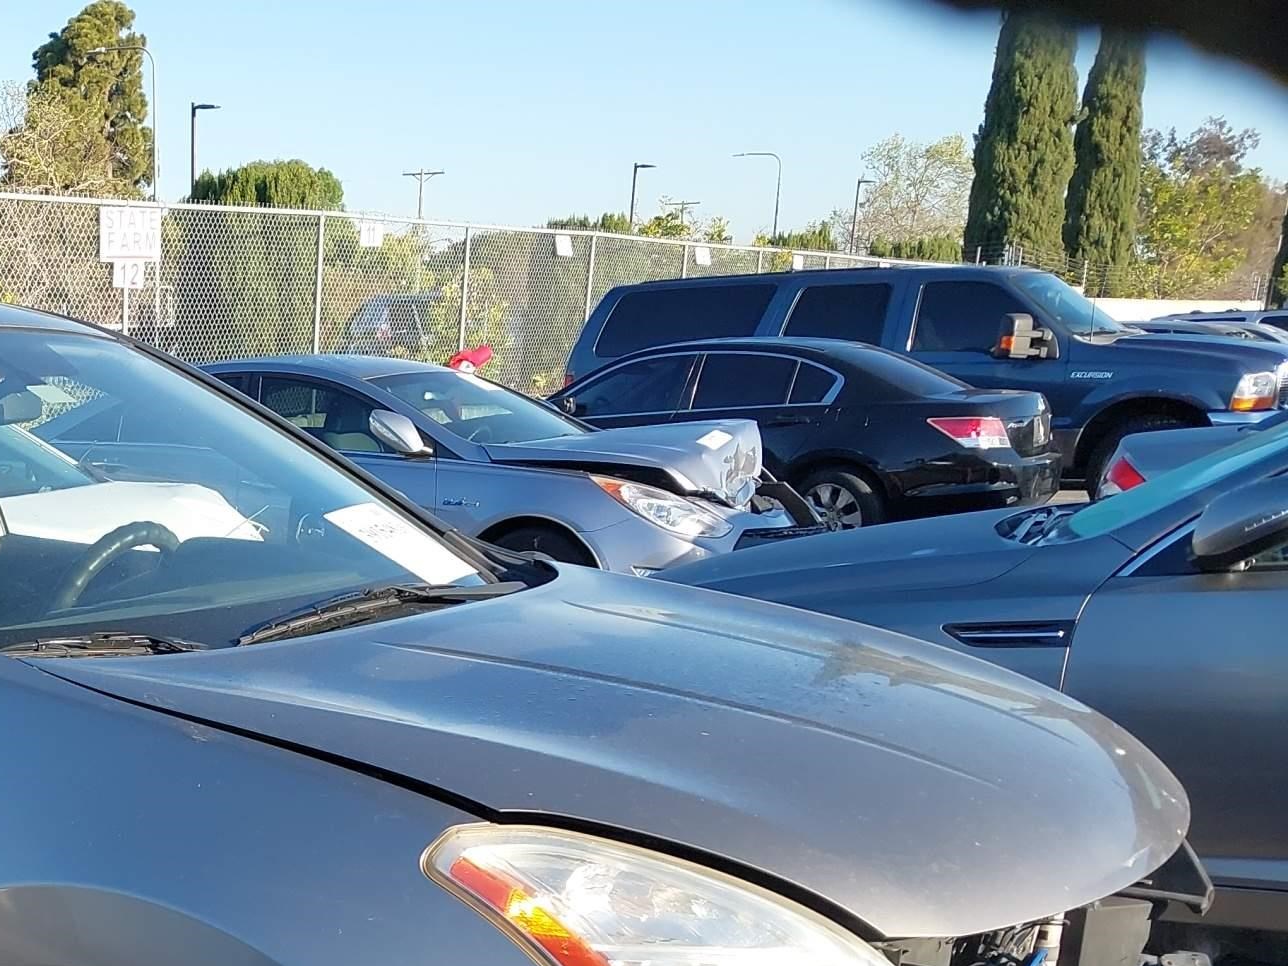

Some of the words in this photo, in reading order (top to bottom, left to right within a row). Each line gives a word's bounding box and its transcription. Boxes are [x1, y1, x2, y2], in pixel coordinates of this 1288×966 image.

[105, 210, 158, 230] STATE
[107, 231, 156, 251] FARM
[120, 263, 139, 285] 12
